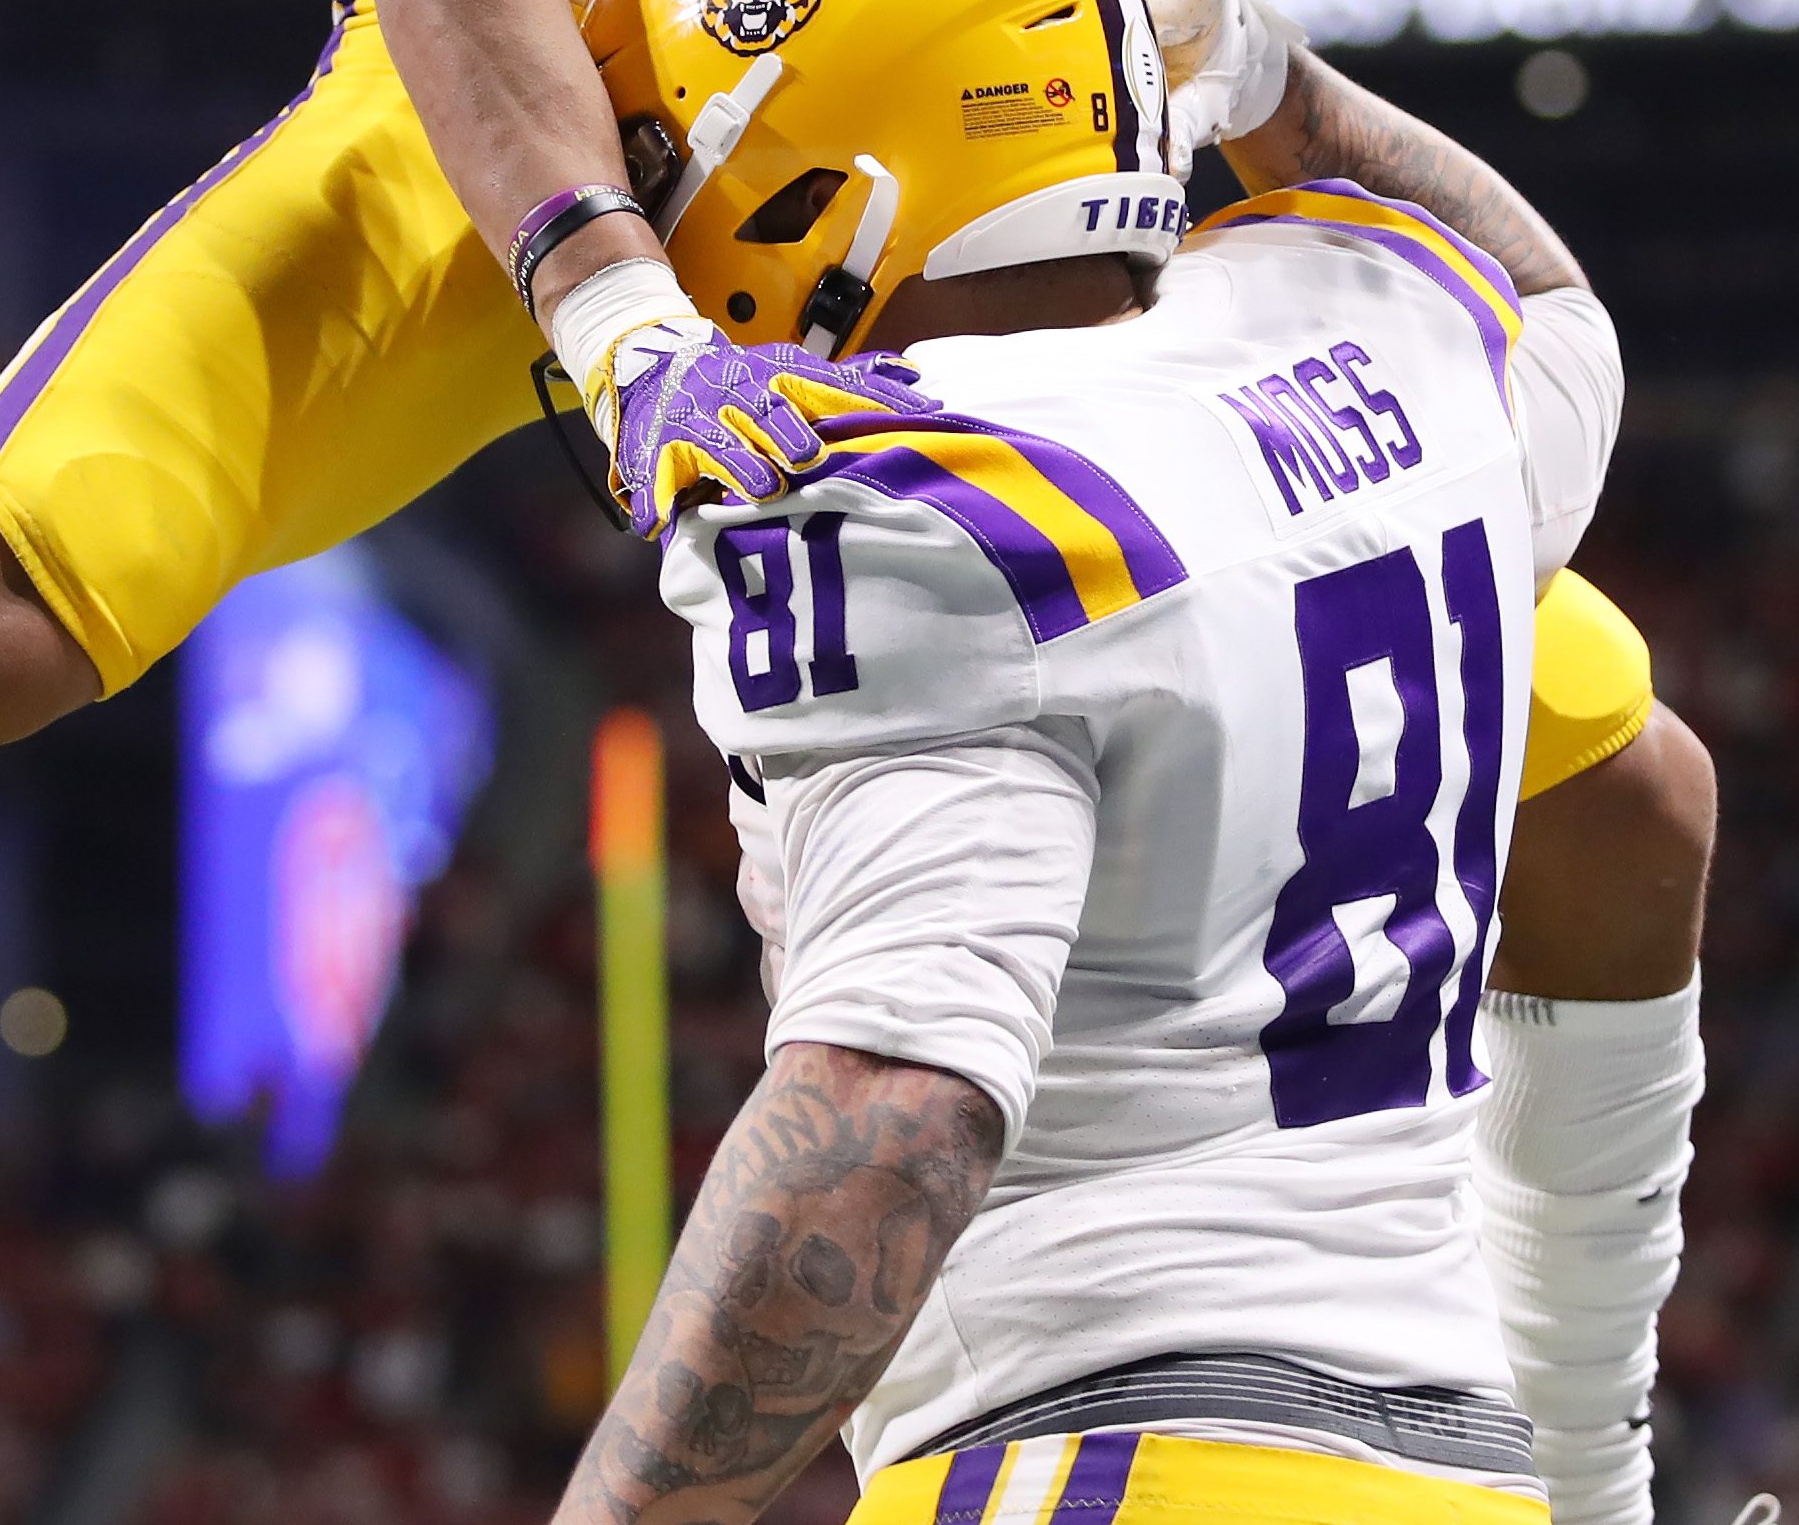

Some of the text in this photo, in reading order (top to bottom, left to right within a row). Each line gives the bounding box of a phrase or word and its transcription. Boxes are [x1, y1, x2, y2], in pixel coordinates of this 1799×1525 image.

[974, 83, 1030, 99] DANGER
[1090, 92, 1109, 132] 8
[1217, 340, 1426, 517] MOSS
[713, 511, 860, 714] 81
[1259, 516, 1504, 1130] 81
